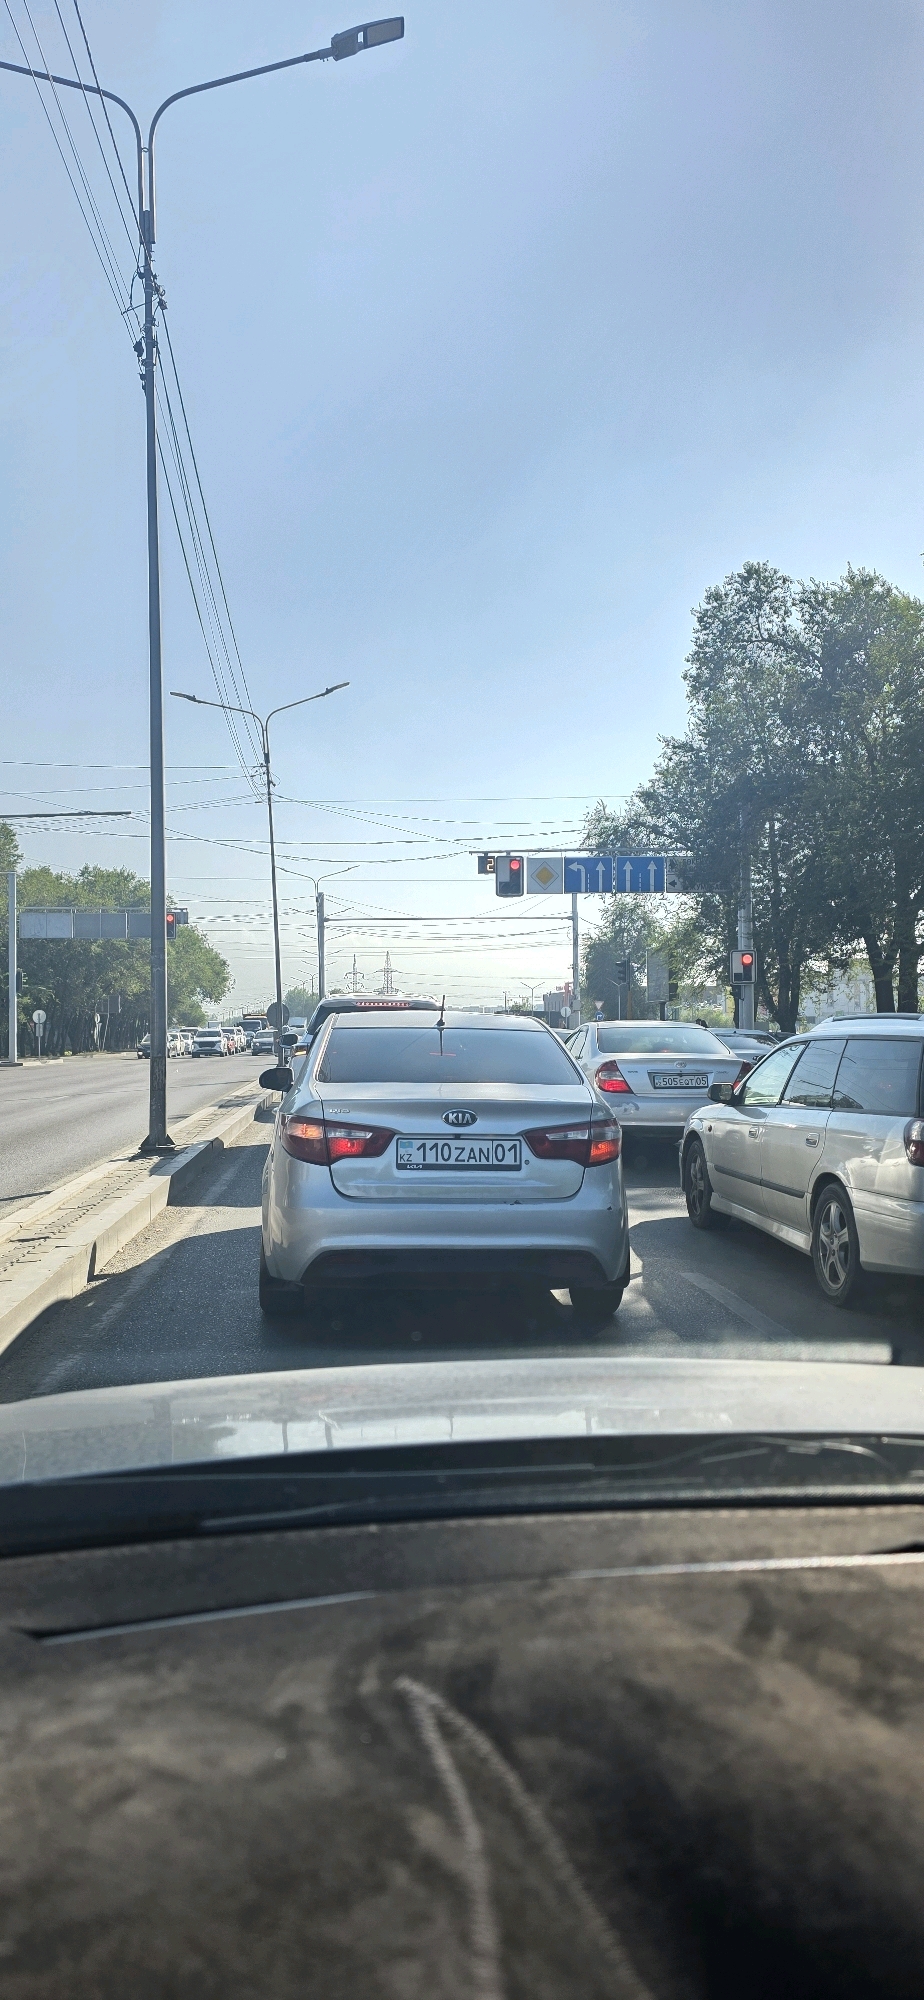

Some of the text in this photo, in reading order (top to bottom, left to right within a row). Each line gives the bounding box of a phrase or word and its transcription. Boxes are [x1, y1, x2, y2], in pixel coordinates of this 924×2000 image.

[696, 1077, 707, 1086] 05
[448, 1112, 472, 1124] KIA
[399, 1153, 413, 1163] KZ
[494, 1143, 518, 1163] 01
